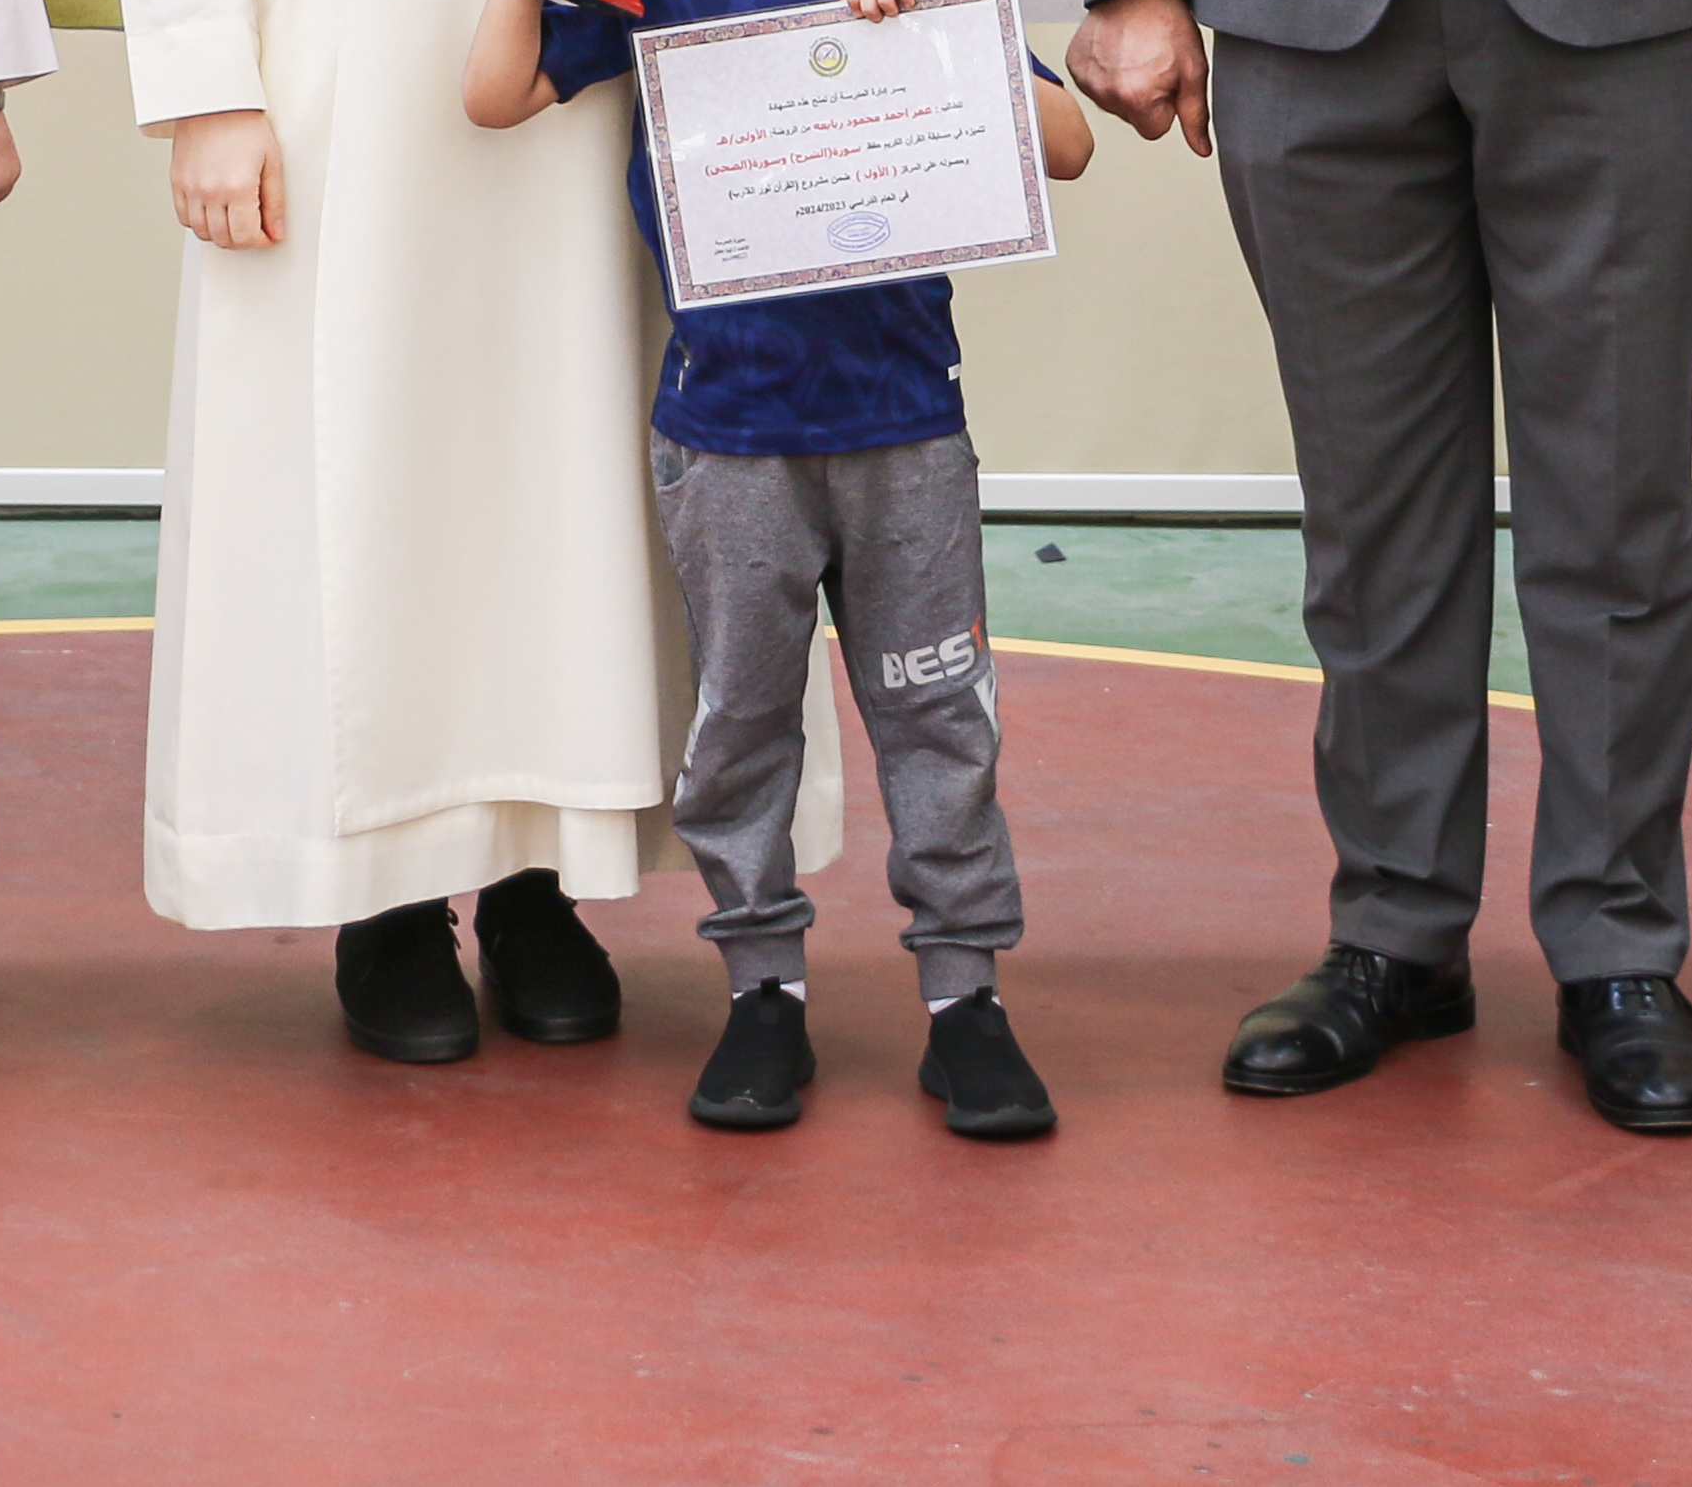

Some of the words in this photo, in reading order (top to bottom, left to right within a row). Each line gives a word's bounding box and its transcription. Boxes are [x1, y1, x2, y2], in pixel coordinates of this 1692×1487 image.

[840, 88, 869, 101] المدرسة
[912, 105, 932, 119] عمر
[847, 115, 881, 128] محمود
